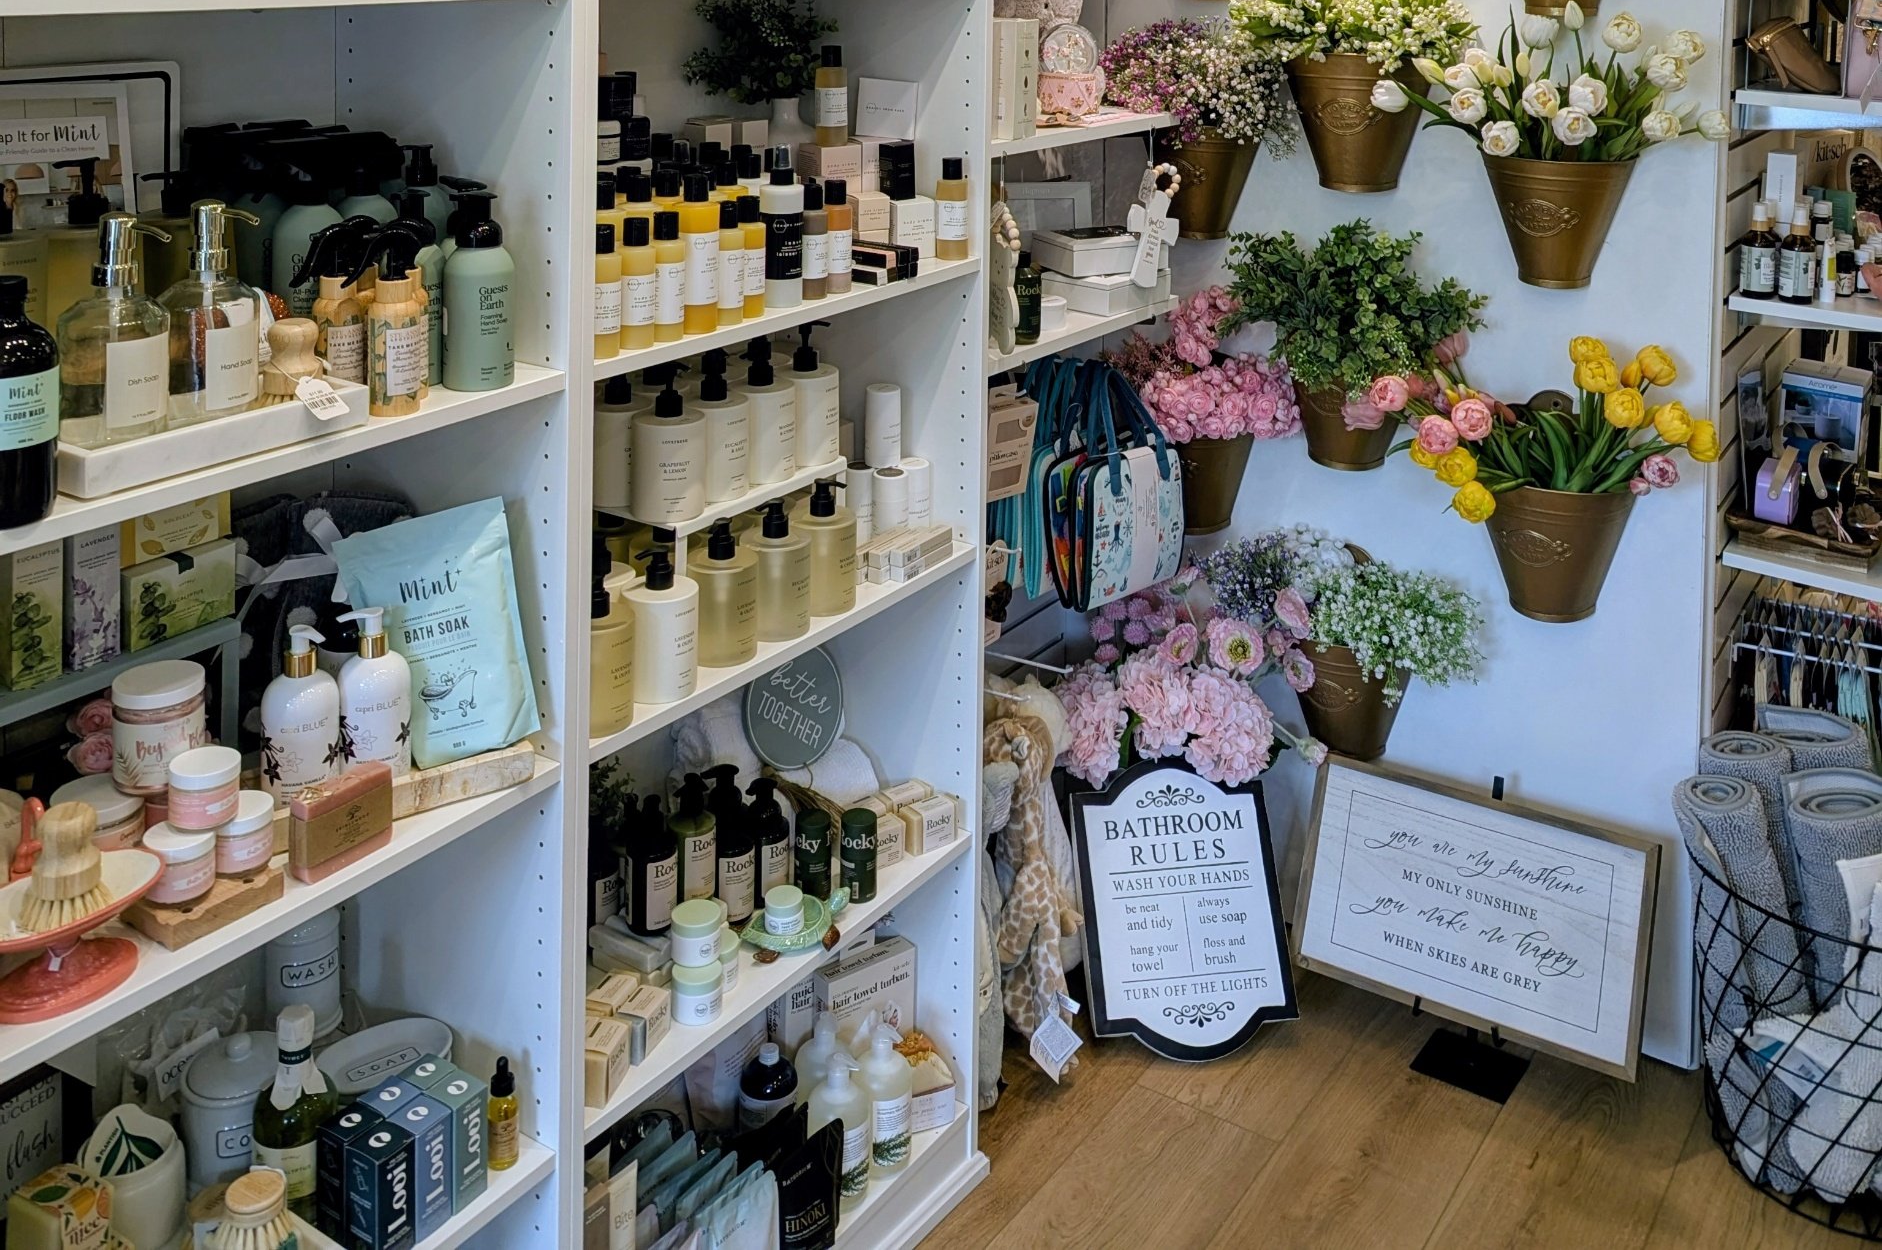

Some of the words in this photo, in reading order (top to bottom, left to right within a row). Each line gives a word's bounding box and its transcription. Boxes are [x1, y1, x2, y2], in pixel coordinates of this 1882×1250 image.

[17, 130, 28, 142] It
[30, 130, 51, 142] for
[53, 123, 100, 142] Mint
[479, 284, 509, 296] Guests
[480, 294, 493, 302] on
[479, 299, 504, 311] Earth
[480, 312, 503, 320] Foaming
[496, 317, 508, 325] Soap
[220, 361, 239, 371] Hand
[240, 357, 253, 367] Soap
[127, 378, 143, 386] Dish
[143, 373, 159, 384] Soap
[8, 383, 41, 400] Mint
[4, 411, 27, 422] FLOOR
[28, 407, 46, 418] WASH
[659, 460, 690, 468] GRAPEFRUIT
[80, 534, 115, 549] LAVENDER
[16, 548, 60, 564] EUCALYPTUS
[399, 570, 457, 604] Mint
[403, 624, 435, 644] BATH
[438, 615, 470, 636] SOAK
[770, 660, 831, 714] better
[376, 697, 400, 711] BLUE
[302, 717, 328, 732] BLUE
[757, 690, 823, 749] TOGETHER
[926, 813, 952, 831] Rocky
[1104, 809, 1244, 841] BATHROOM
[1130, 838, 1227, 866] RULES
[1363, 828, 1424, 850] you
[1432, 838, 1458, 857] are
[1457, 850, 1503, 878] my
[1499, 859, 1588, 896] sunshine
[1112, 876, 1154, 892] WASH
[1159, 873, 1197, 889] YOUR
[1200, 868, 1250, 885] HANDS
[1197, 896, 1230, 909] always
[1401, 868, 1422, 883] MY
[1425, 876, 1462, 898] ONLY
[1465, 888, 1538, 921] SUNSHINE
[1125, 903, 1137, 915] be
[1139, 902, 1160, 913] neat
[1127, 918, 1148, 931] and
[1150, 916, 1174, 932] tidy
[1199, 913, 1218, 924] use
[1221, 911, 1247, 926] soap
[1203, 937, 1226, 949] floss
[1228, 935, 1246, 947] and
[1349, 895, 1409, 915] you
[1417, 905, 1470, 934] make
[1479, 926, 1507, 945] me
[1511, 931, 1585, 978] happy
[1130, 943, 1154, 957] hang
[1155, 943, 1179, 956] your
[1131, 958, 1164, 973] towel
[1204, 952, 1237, 966] brush
[1383, 930, 1424, 954] WHEN
[1427, 944, 1467, 969] SKIES
[1470, 960, 1499, 980] ARE
[1502, 970, 1541, 994] GREY
[288, 956, 336, 981] WASH
[823, 967, 840, 978] hair
[841, 958, 862, 974] towel
[791, 981, 815, 1000] quic
[832, 995, 852, 1010] hair
[853, 982, 878, 1001] towel
[880, 971, 910, 990] turban.
[1123, 986, 1160, 1001] TURN
[1164, 983, 1188, 997] OFF
[1192, 980, 1218, 994] THE
[1221, 976, 1268, 992] LIGHTS
[791, 995, 812, 1010] hair
[648, 1002, 668, 1032] Rocky
[357, 1052, 408, 1077] SOAP
[6, 1120, 55, 1180] flush
[614, 1209, 634, 1230] Bite
[785, 1203, 827, 1232] HINOKI
